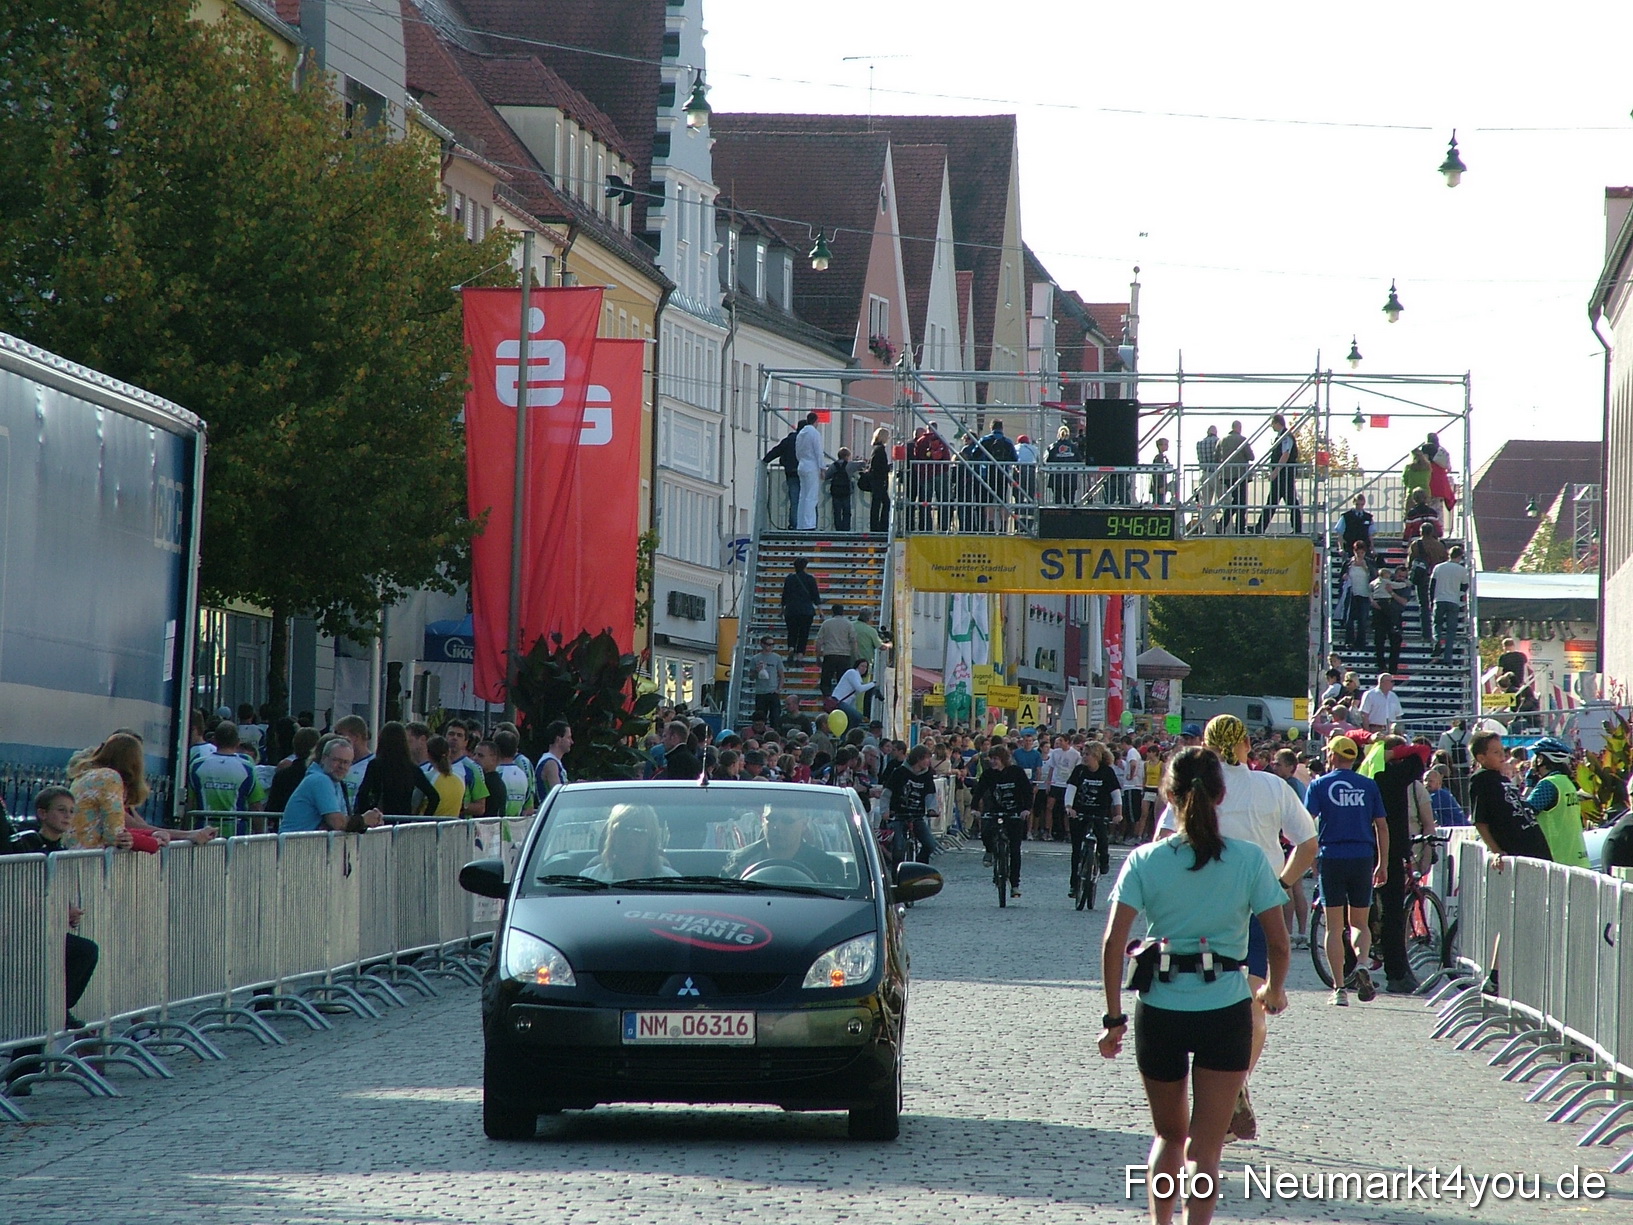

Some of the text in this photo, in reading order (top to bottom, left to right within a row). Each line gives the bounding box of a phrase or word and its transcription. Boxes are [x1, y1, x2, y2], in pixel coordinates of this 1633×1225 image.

[931, 563, 1017, 573] Neumarkter Stadtlauf
[1040, 548, 1178, 580] START
[1252, 567, 1289, 575] Stadtlauf
[1021, 704, 1034, 720] A
[623, 910, 747, 933] GERHART
[640, 1015, 749, 1036] NM 06316
